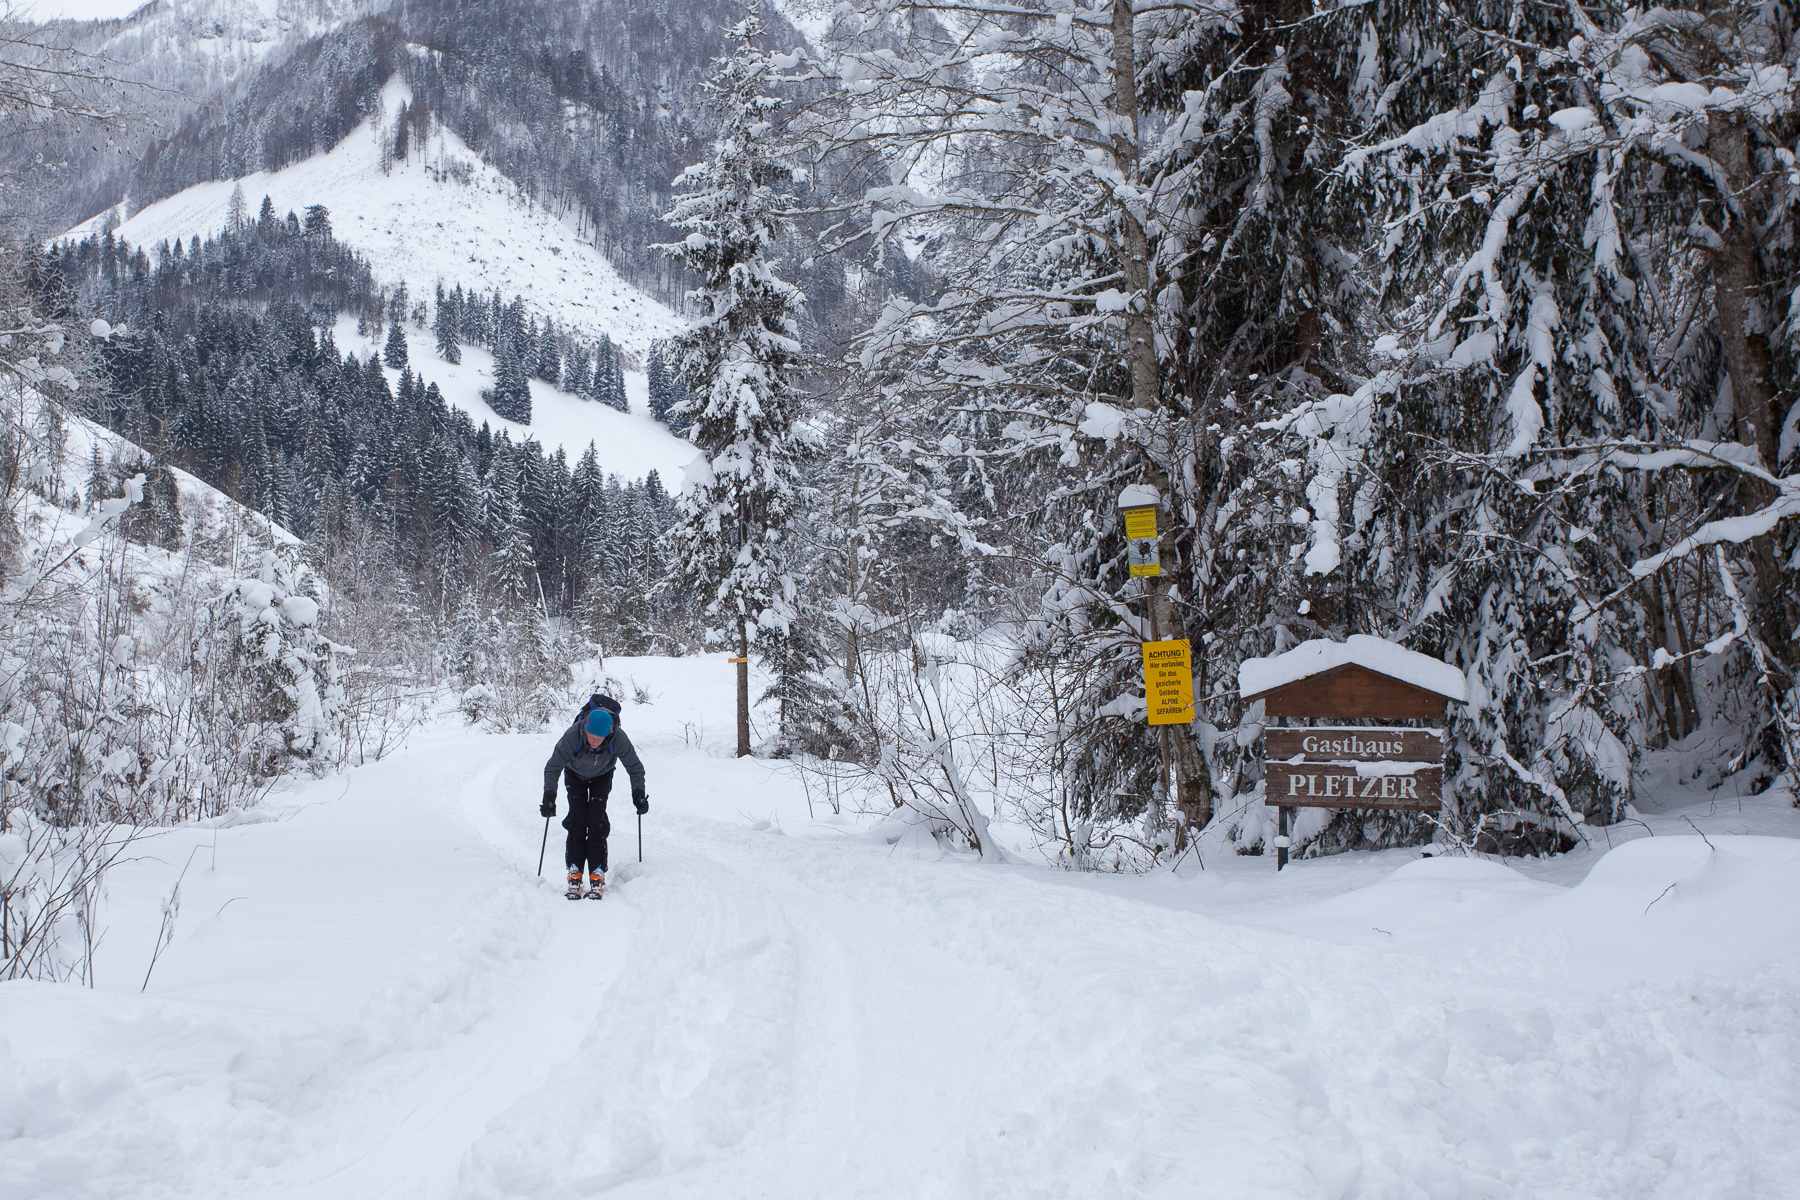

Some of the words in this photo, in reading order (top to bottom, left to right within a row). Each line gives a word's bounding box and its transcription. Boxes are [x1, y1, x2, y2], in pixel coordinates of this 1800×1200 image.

[1149, 650, 1181, 658] ACHTUNG
[1155, 680, 1181, 688] gesicherte
[1156, 707, 1182, 715] GEFAHREN
[1302, 736, 1403, 755] Gasthaus
[1287, 774, 1419, 799] PLETZER
